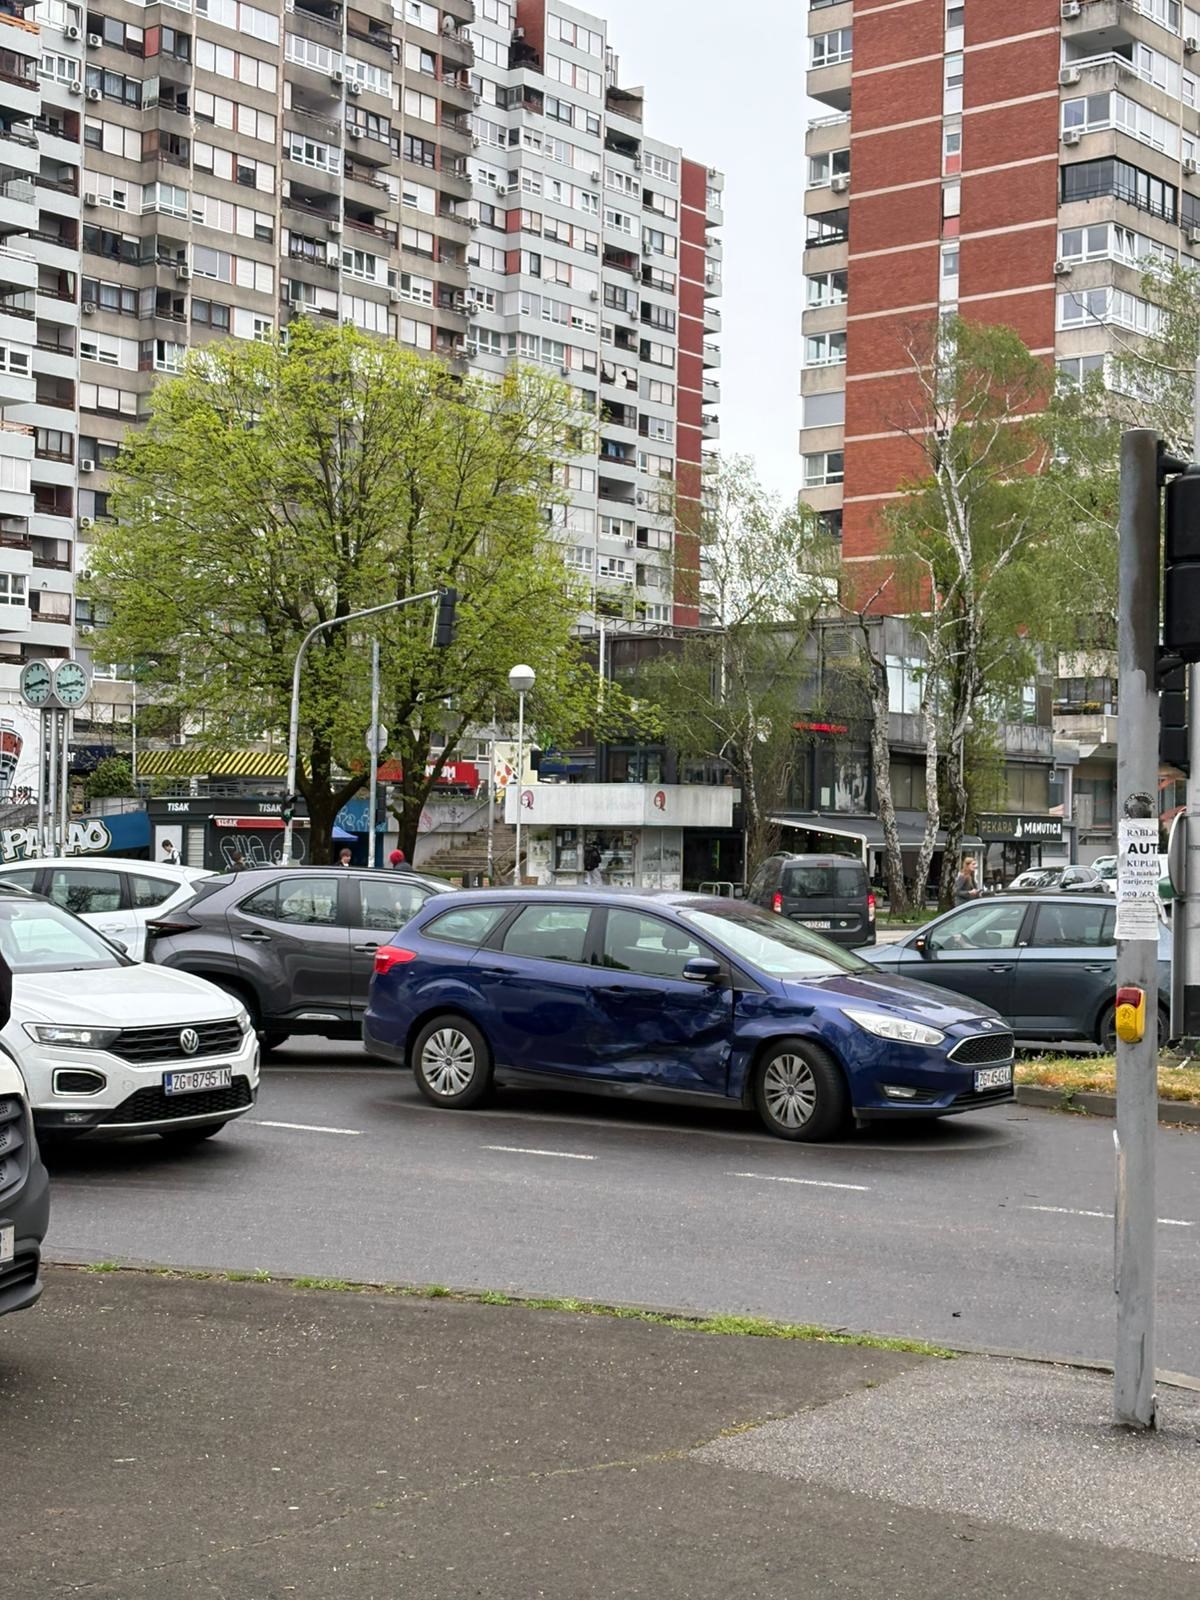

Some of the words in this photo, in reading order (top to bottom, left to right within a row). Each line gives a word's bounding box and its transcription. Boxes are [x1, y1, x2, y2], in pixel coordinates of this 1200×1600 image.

[167, 802, 190, 812] TISAK
[258, 803, 282, 813] TISAK
[982, 820, 1013, 833] PEKARA
[1024, 822, 1062, 835] MAMUTICA
[173, 1074, 186, 1090] ZG
